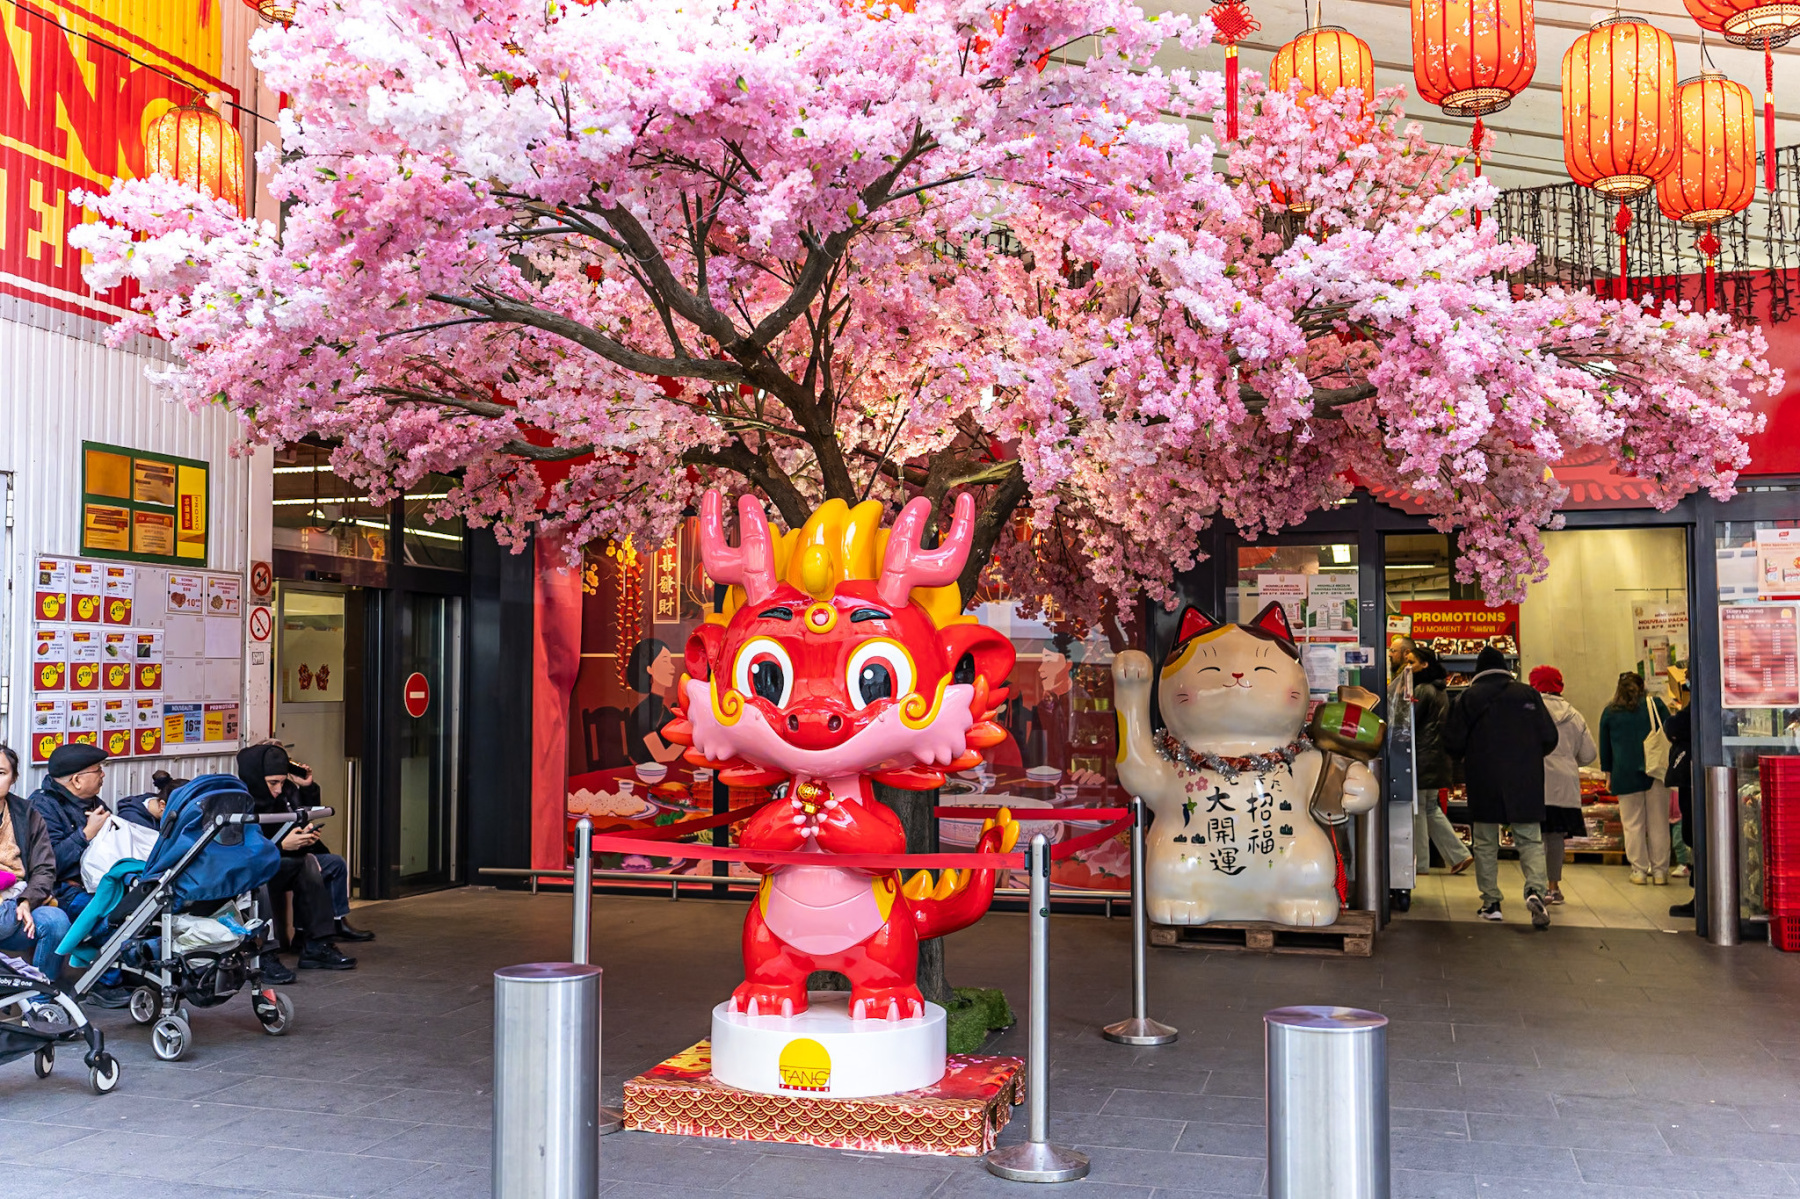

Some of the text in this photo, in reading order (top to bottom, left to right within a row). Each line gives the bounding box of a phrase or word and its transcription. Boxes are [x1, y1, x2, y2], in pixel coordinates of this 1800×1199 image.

[1413, 612, 1506, 622] PROMOTIONS
[1413, 625, 1425, 633] DU
[1426, 625, 1461, 633] MOMENT
[1206, 786, 1247, 876] 大開運
[1246, 792, 1275, 855] 招福
[779, 1068, 831, 1086] TANG
